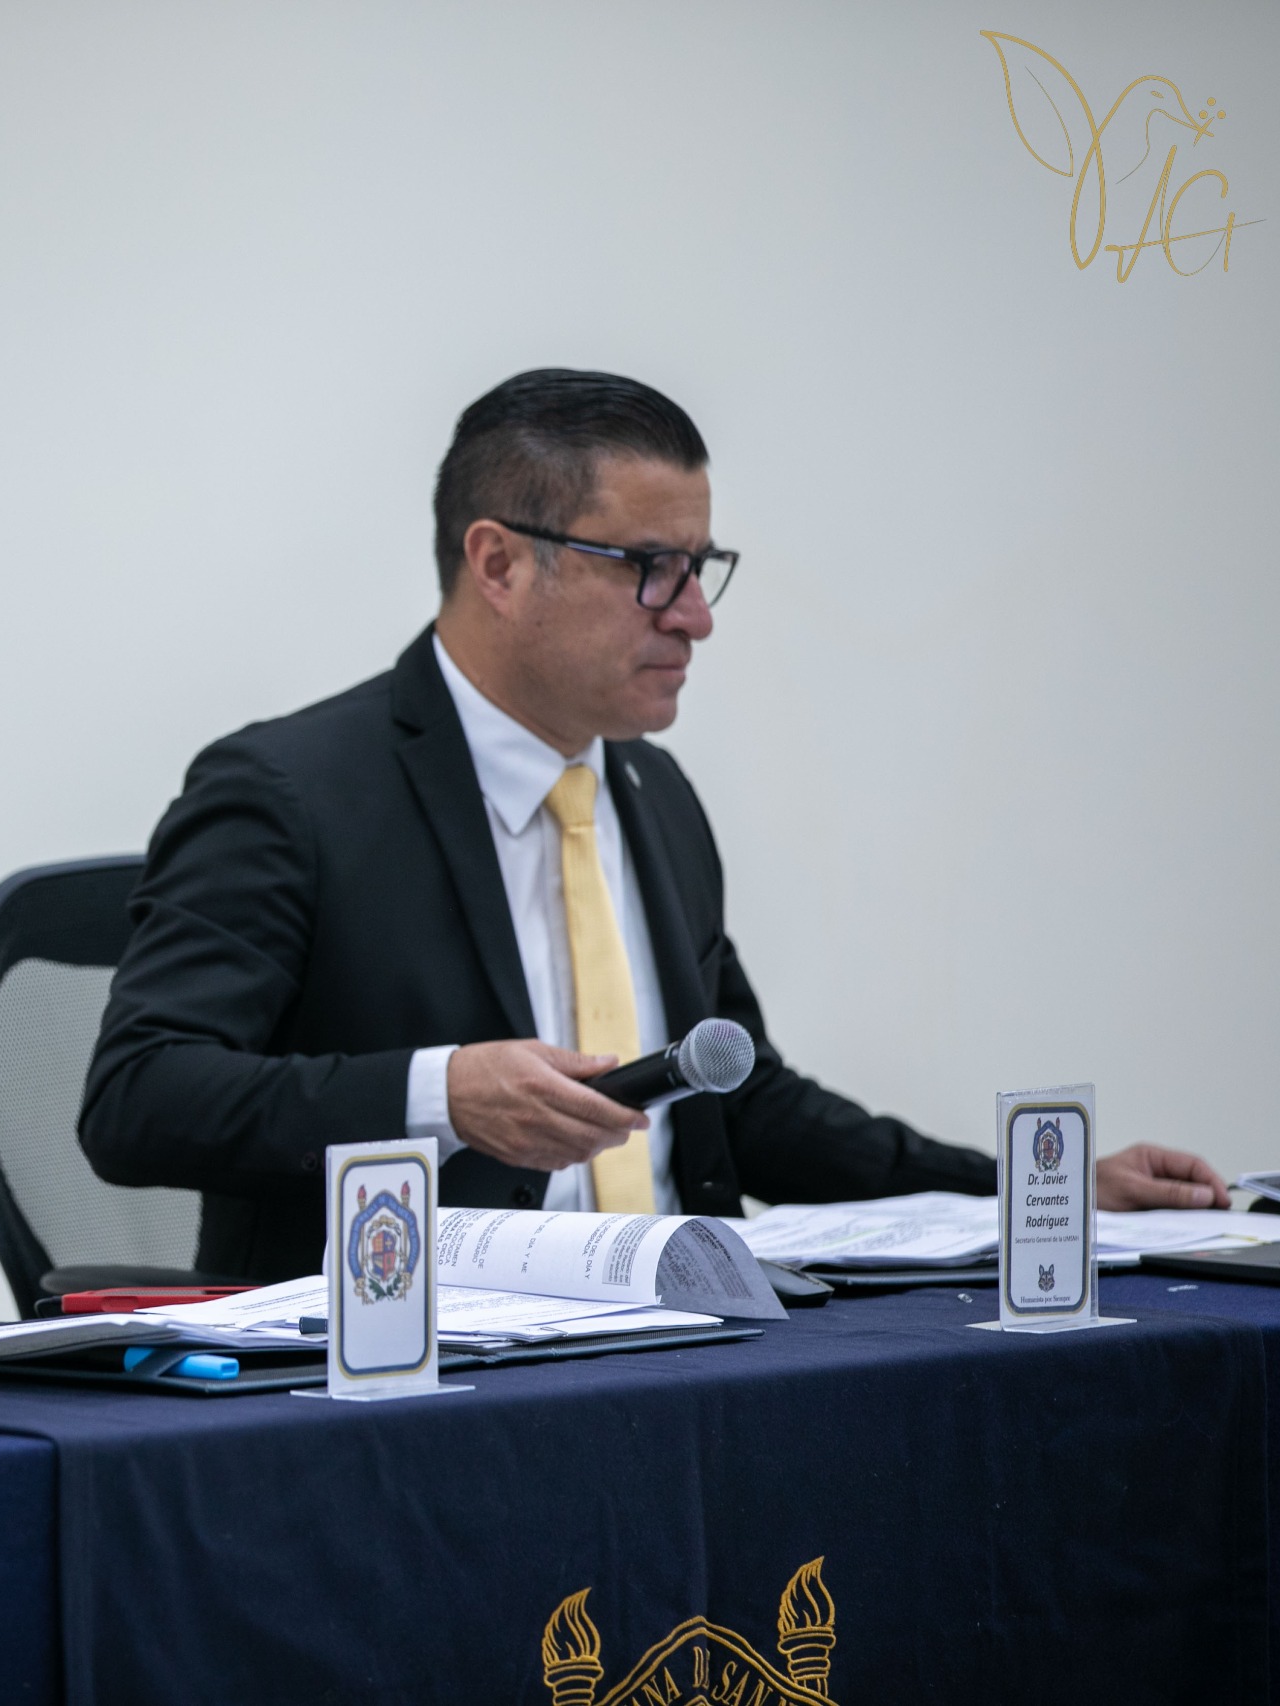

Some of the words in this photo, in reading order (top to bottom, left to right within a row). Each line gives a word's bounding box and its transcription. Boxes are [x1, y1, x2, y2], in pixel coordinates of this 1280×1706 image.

[1027, 1173, 1040, 1186] Dr.
[1041, 1171, 1068, 1186] Javier
[1026, 1194, 1070, 1207] Cervantes
[1025, 1213, 1070, 1230] Rodríguez
[1014, 1236, 1036, 1244] Secretario
[1036, 1235, 1052, 1244] General
[1052, 1235, 1058, 1243] de
[1058, 1234, 1063, 1242] la
[437, 1242, 448, 1266] CICLO
[588, 1245, 598, 1258] DEL
[477, 1258, 485, 1270] DE
[584, 1273, 591, 1281] Y
[1044, 1297, 1053, 1305] por
[710, 1660, 774, 1706] SAN
